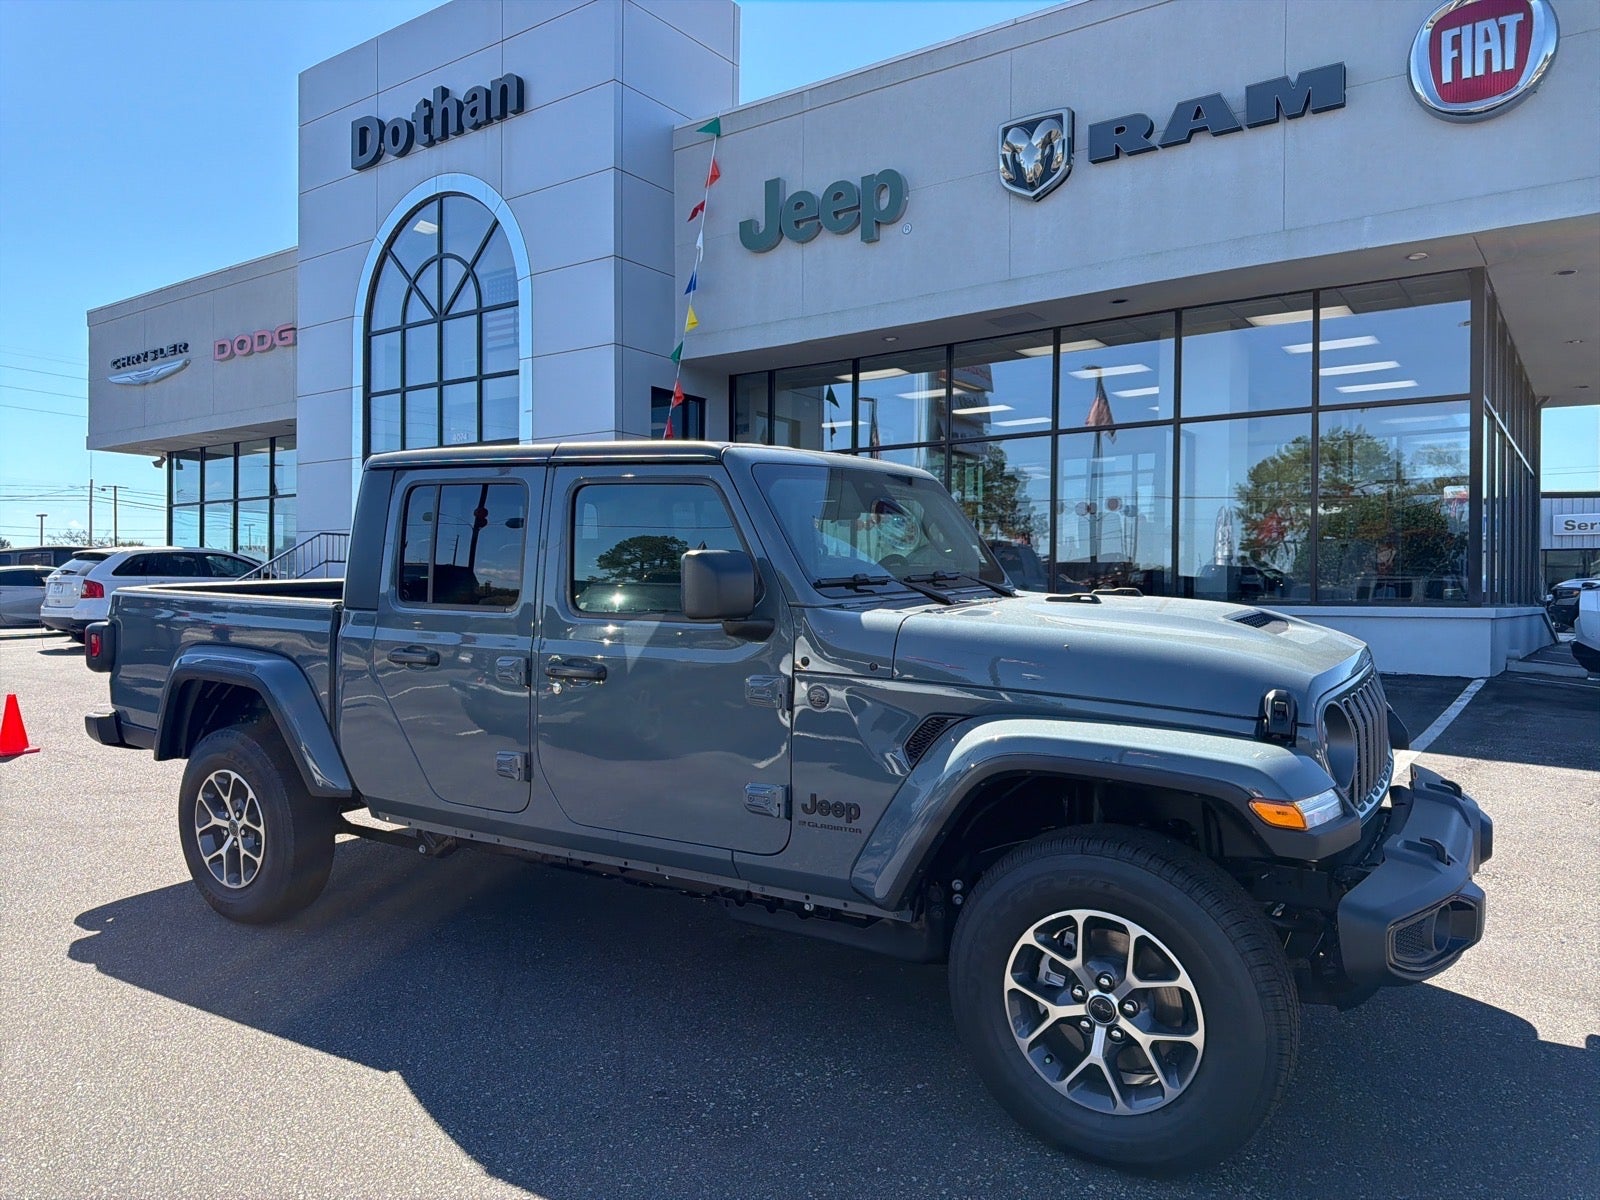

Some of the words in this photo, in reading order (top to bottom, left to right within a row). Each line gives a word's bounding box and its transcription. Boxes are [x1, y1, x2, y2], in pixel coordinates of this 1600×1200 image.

[1440, 12, 1524, 85] FIAT
[351, 72, 525, 171] Dothan
[1088, 61, 1346, 164] RAM
[739, 168, 909, 253] Jeep
[110, 342, 190, 369] CHRYSLER
[1564, 519, 1600, 531] Ser
[801, 793, 861, 823] Jeep
[807, 821, 862, 834] GLADIATOR
